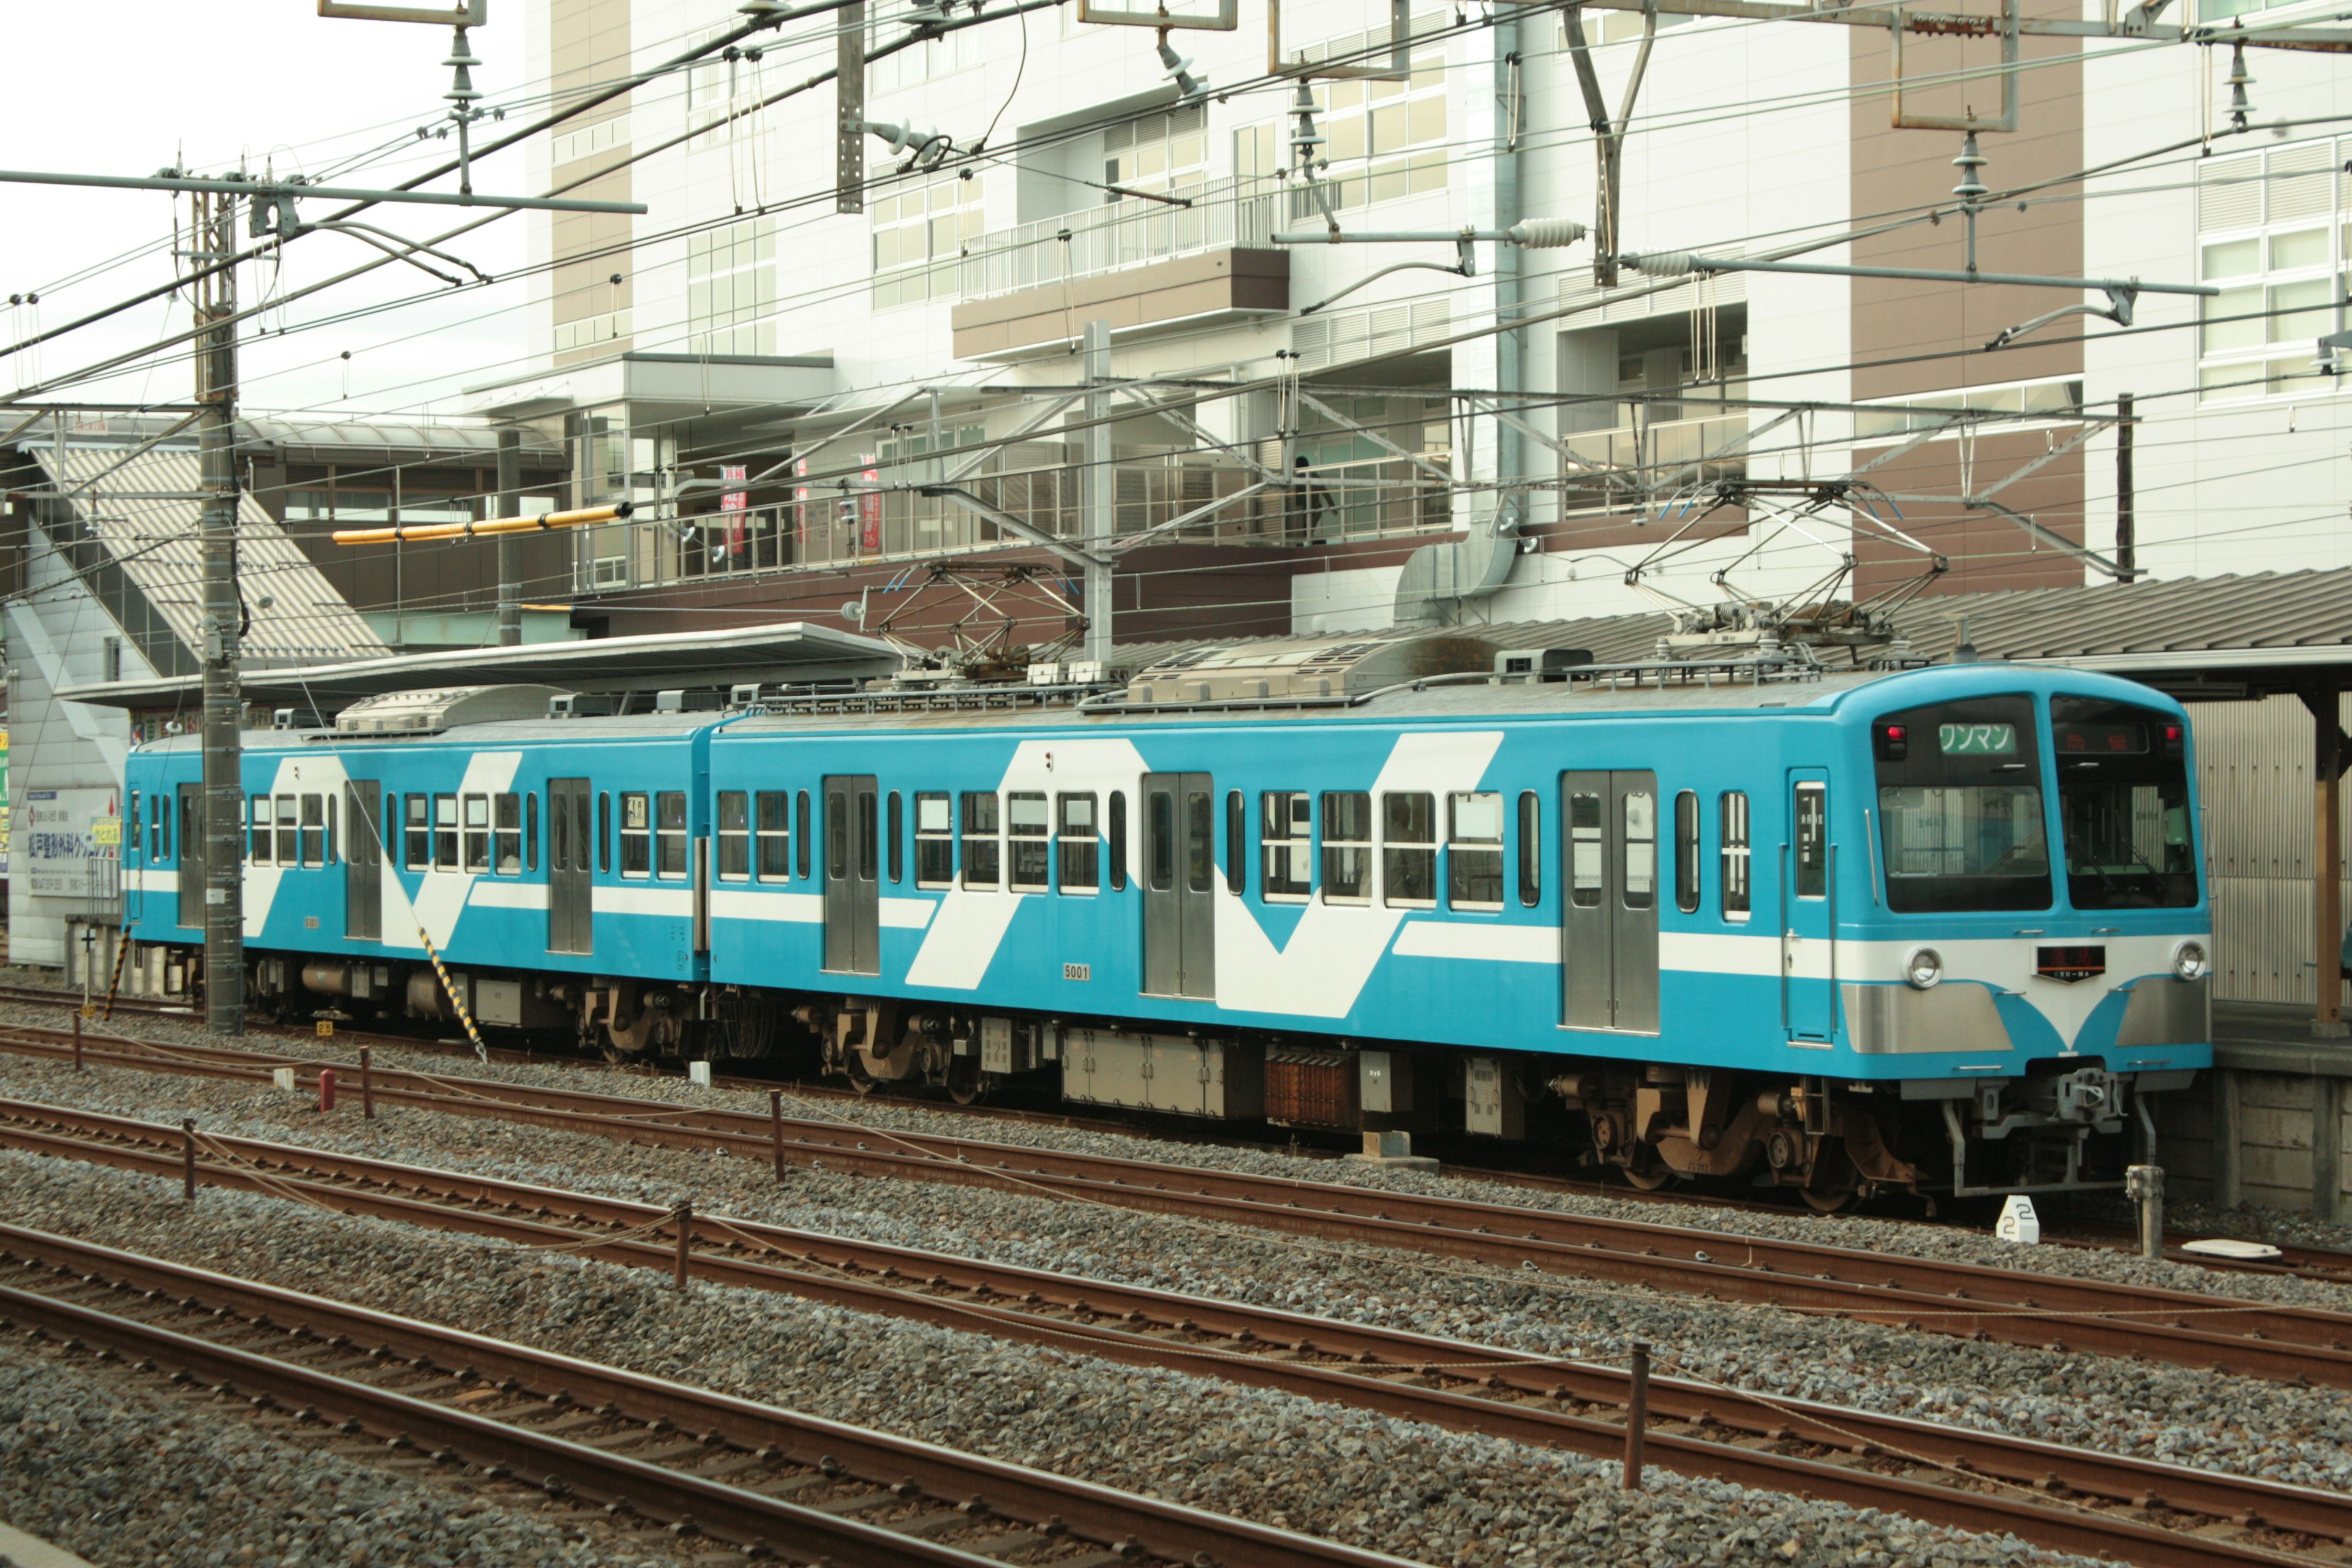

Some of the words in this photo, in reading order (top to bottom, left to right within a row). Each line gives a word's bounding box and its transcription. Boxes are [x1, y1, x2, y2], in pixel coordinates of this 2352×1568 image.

[1939, 725, 2010, 750] ワンマン
[1065, 965, 1087, 979] 5001
[318, 1023, 331, 1033] 25
[2016, 1204, 2034, 1219] 2
[2003, 1216, 2015, 1234] 2
